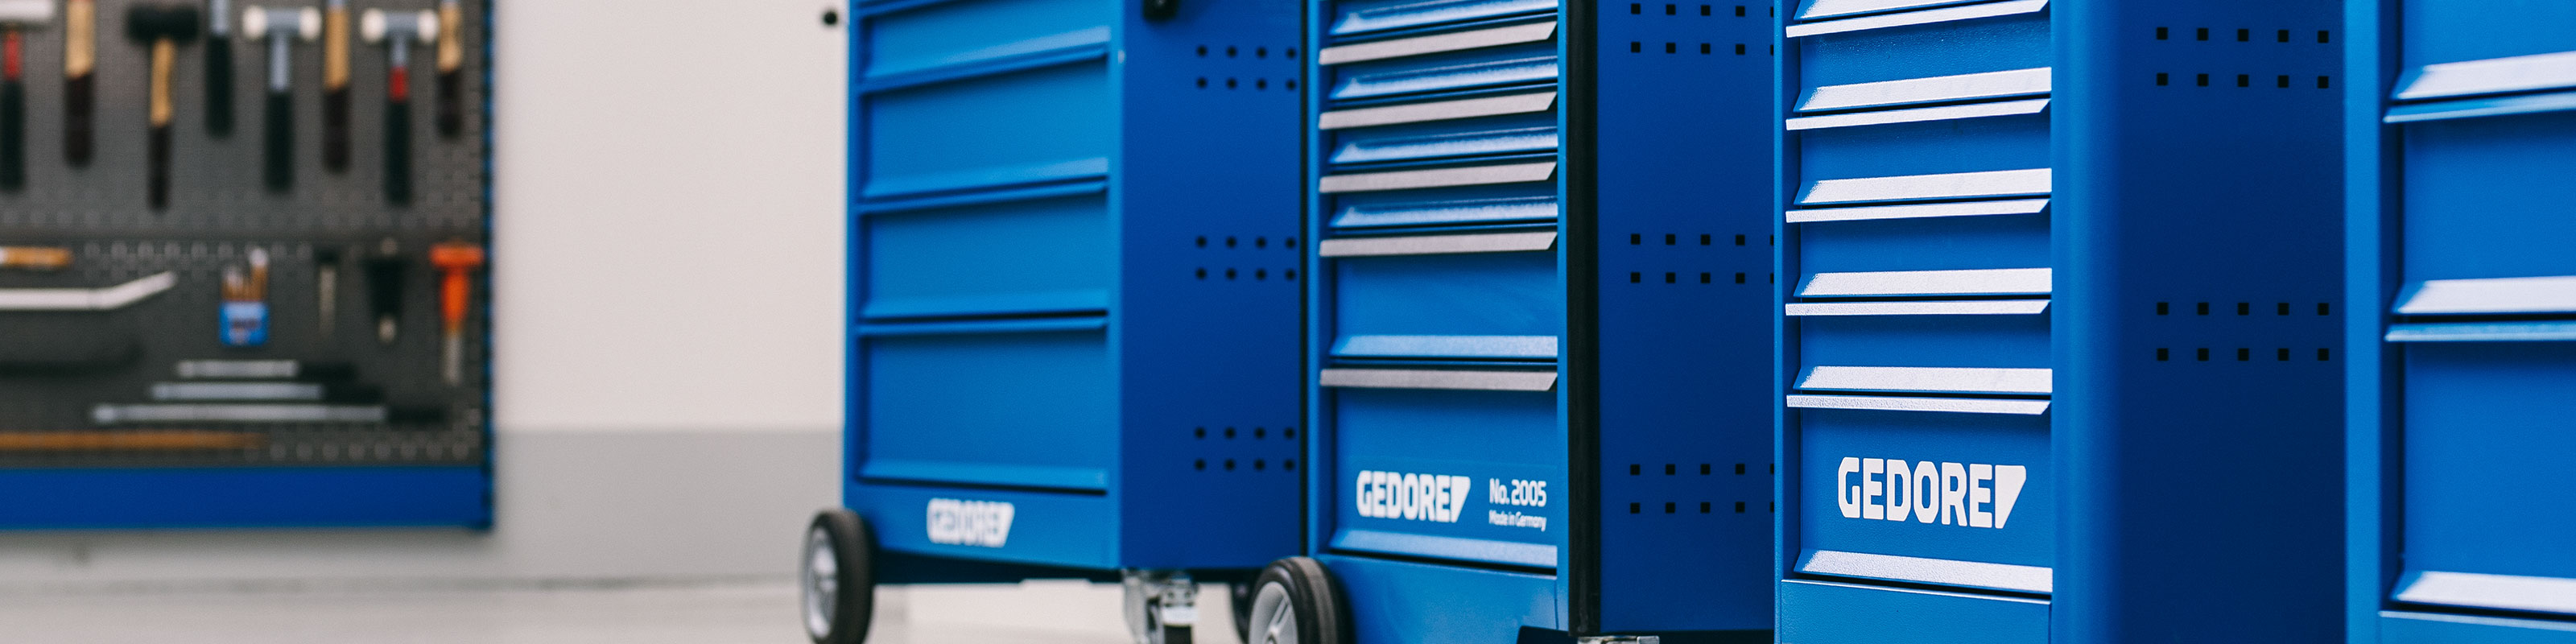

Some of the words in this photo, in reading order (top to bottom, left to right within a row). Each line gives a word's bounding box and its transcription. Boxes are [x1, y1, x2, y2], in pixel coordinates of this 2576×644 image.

[1356, 470, 1451, 522] GEDORE
[1489, 477, 1510, 505] No.
[1511, 479, 1547, 507] 2005
[1837, 456, 1993, 528] GEDORE
[1488, 510, 1508, 526] Made
[1508, 511, 1515, 526] in
[1515, 511, 1547, 532] Germany
